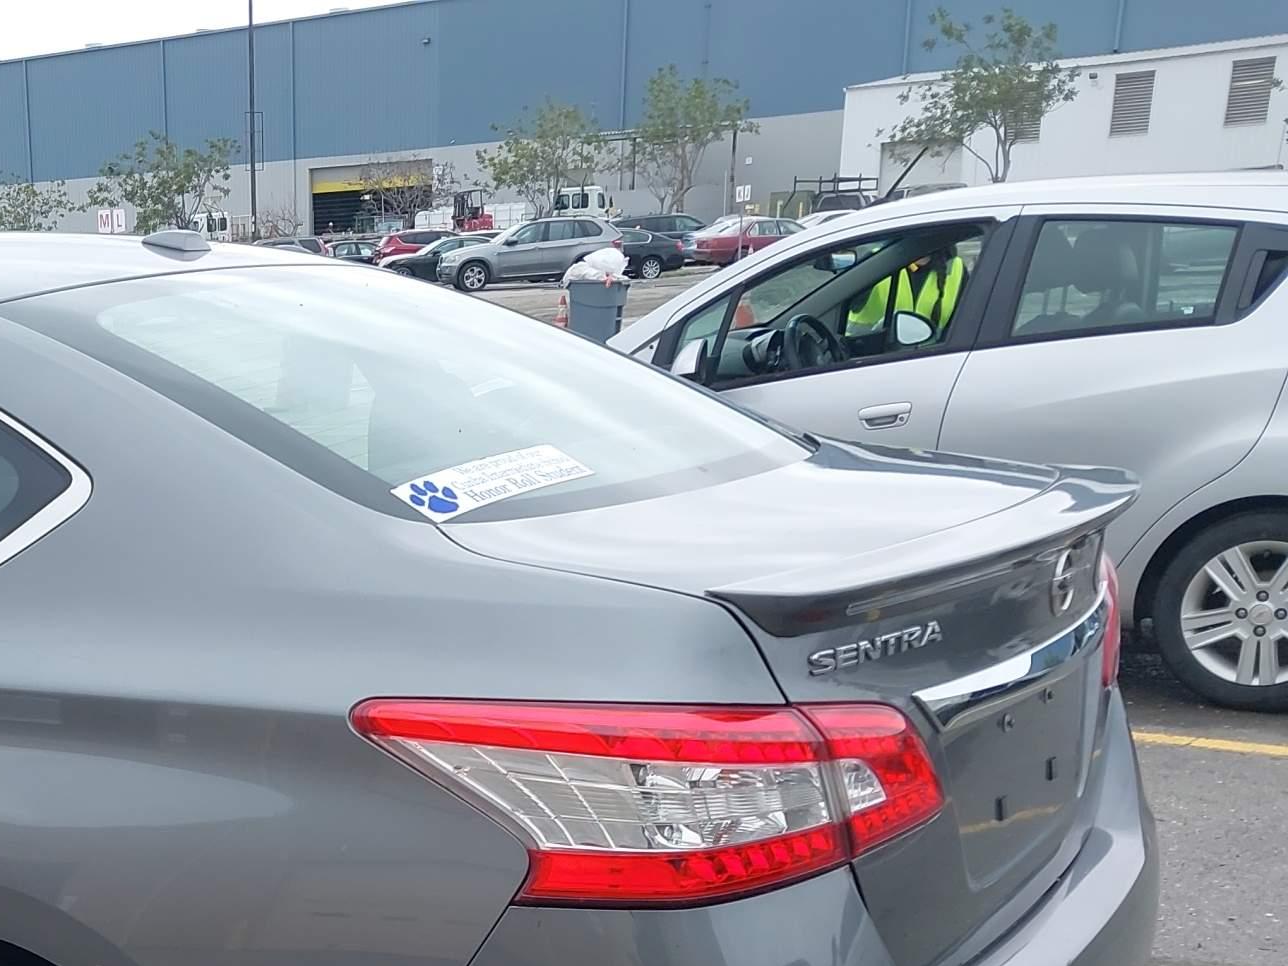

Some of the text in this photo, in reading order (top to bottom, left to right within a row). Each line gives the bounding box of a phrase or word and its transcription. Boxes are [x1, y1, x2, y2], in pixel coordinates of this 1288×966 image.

[99, 213, 110, 229] M
[116, 213, 123, 228] L
[463, 484, 512, 503] Honor
[506, 472, 542, 490] Roll
[534, 464, 589, 482] Student
[807, 620, 942, 676] SENTRA
